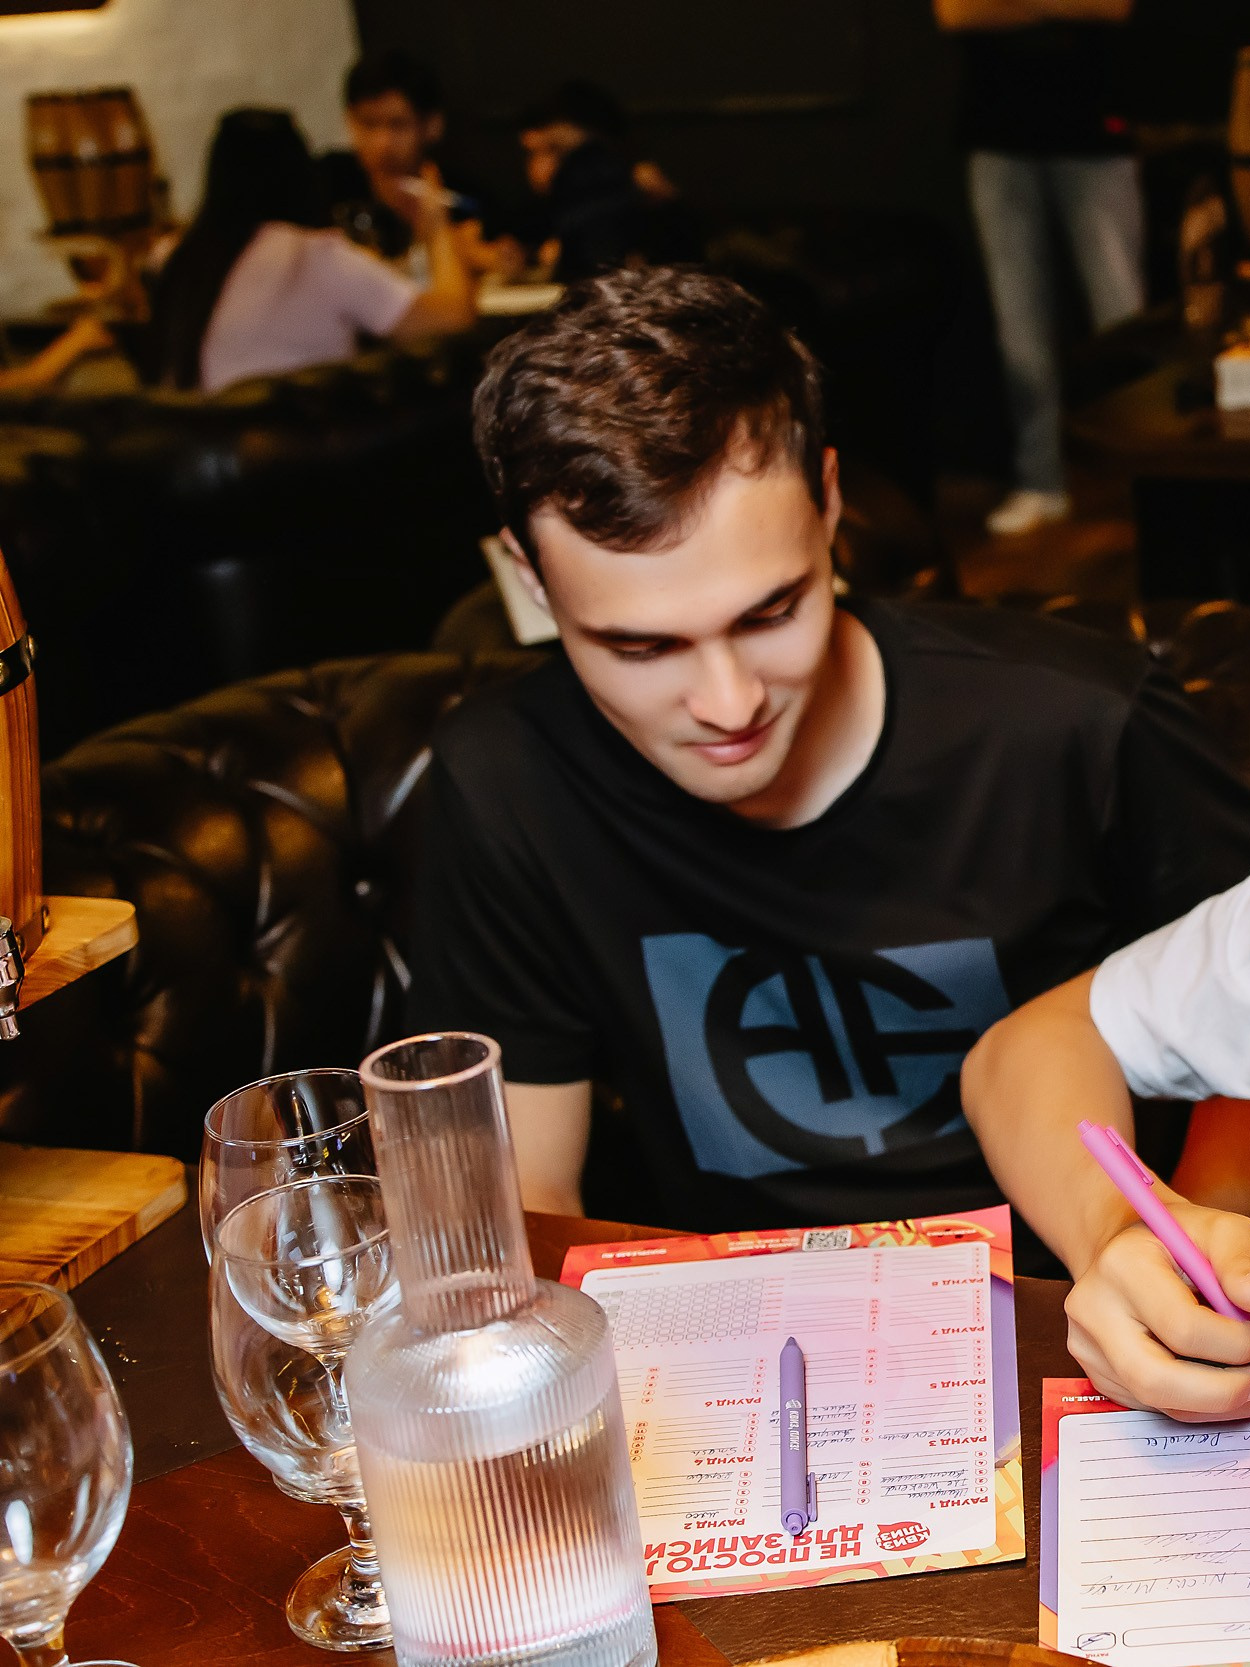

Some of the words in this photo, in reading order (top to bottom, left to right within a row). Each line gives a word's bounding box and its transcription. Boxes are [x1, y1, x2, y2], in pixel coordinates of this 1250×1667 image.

[942, 1278, 984, 1286] РАУНД
[941, 1326, 984, 1334] РАУНД
[939, 1378, 986, 1388] РАУНД
[716, 1397, 761, 1406] РАУНД
[939, 1435, 987, 1445] РАУНД
[706, 1455, 754, 1465] РАУНД
[940, 1496, 988, 1507] РАУНД
[696, 1518, 745, 1529] РАУНД
[792, 1523, 864, 1546] ДЛЯ
[643, 1533, 784, 1559] ЗАПИСИ
[820, 1541, 861, 1560] НЕ
[667, 1546, 810, 1573] ПРОСТО
